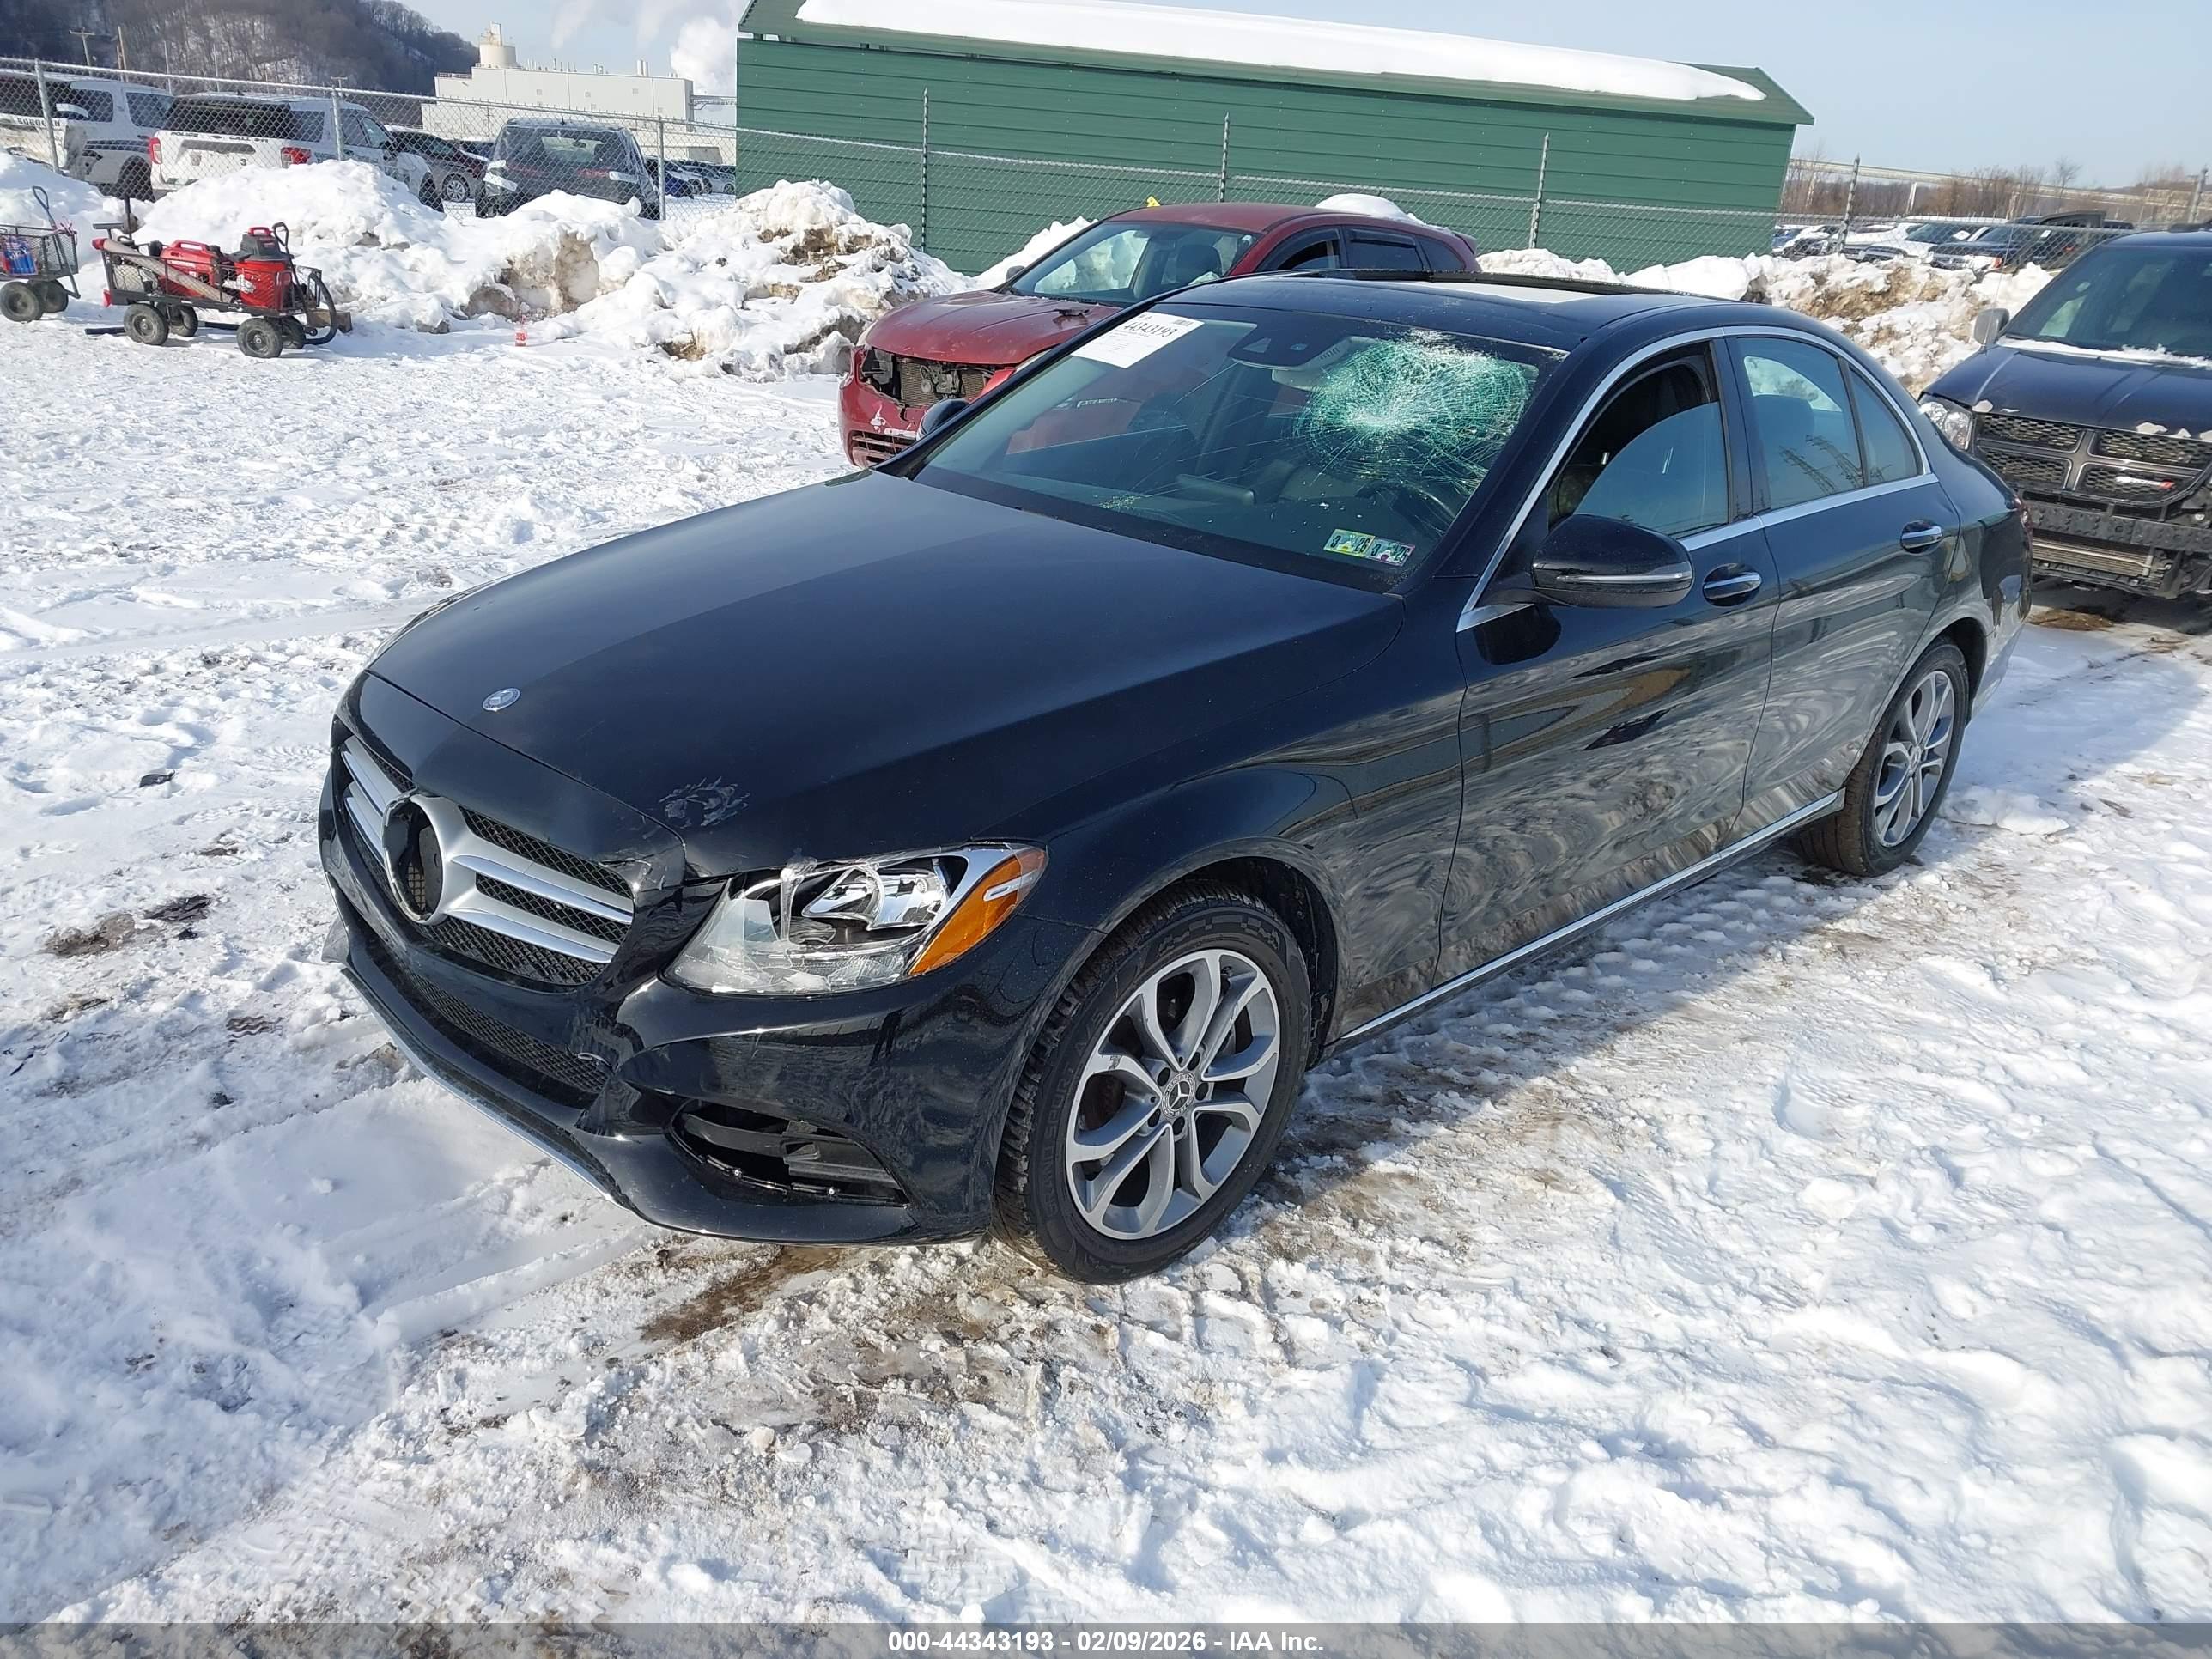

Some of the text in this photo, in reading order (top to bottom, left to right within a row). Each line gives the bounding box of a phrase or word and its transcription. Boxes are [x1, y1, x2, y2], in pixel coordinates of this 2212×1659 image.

[240, 158, 247, 167] 3
[1123, 321, 1178, 337] 44343193
[1330, 535, 1371, 553] 3 26
[1370, 543, 1382, 556] 3
